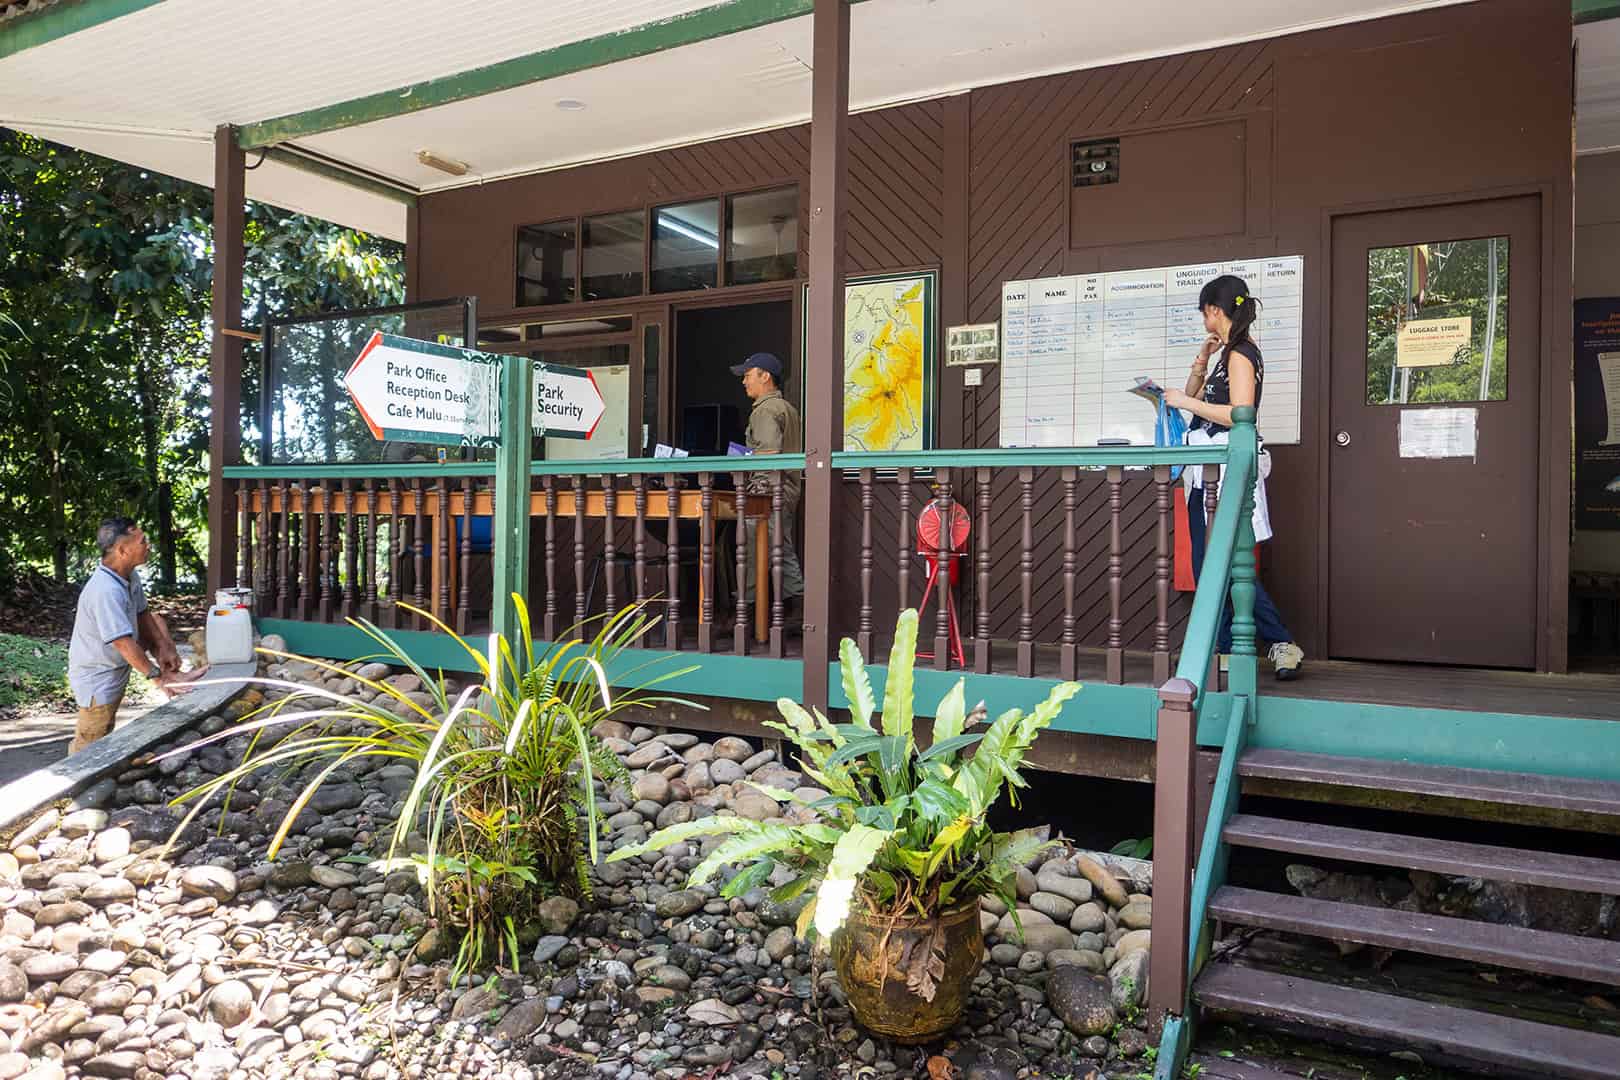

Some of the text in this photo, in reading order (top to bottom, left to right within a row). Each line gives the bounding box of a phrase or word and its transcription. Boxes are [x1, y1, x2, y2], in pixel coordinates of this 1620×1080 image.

[1175, 268, 1218, 278] UNGUIDED
[1267, 270, 1296, 278] RETURN
[1175, 279, 1203, 287] TRAILS
[1045, 290, 1067, 298] NAME
[1409, 326, 1438, 334] LUGGAGE
[386, 361, 447, 383] Park Office
[386, 381, 471, 404] Reception Desk
[538, 383, 564, 400] Park
[387, 403, 413, 418] Cafe
[416, 406, 442, 420] Mulu
[537, 398, 583, 421] Security
